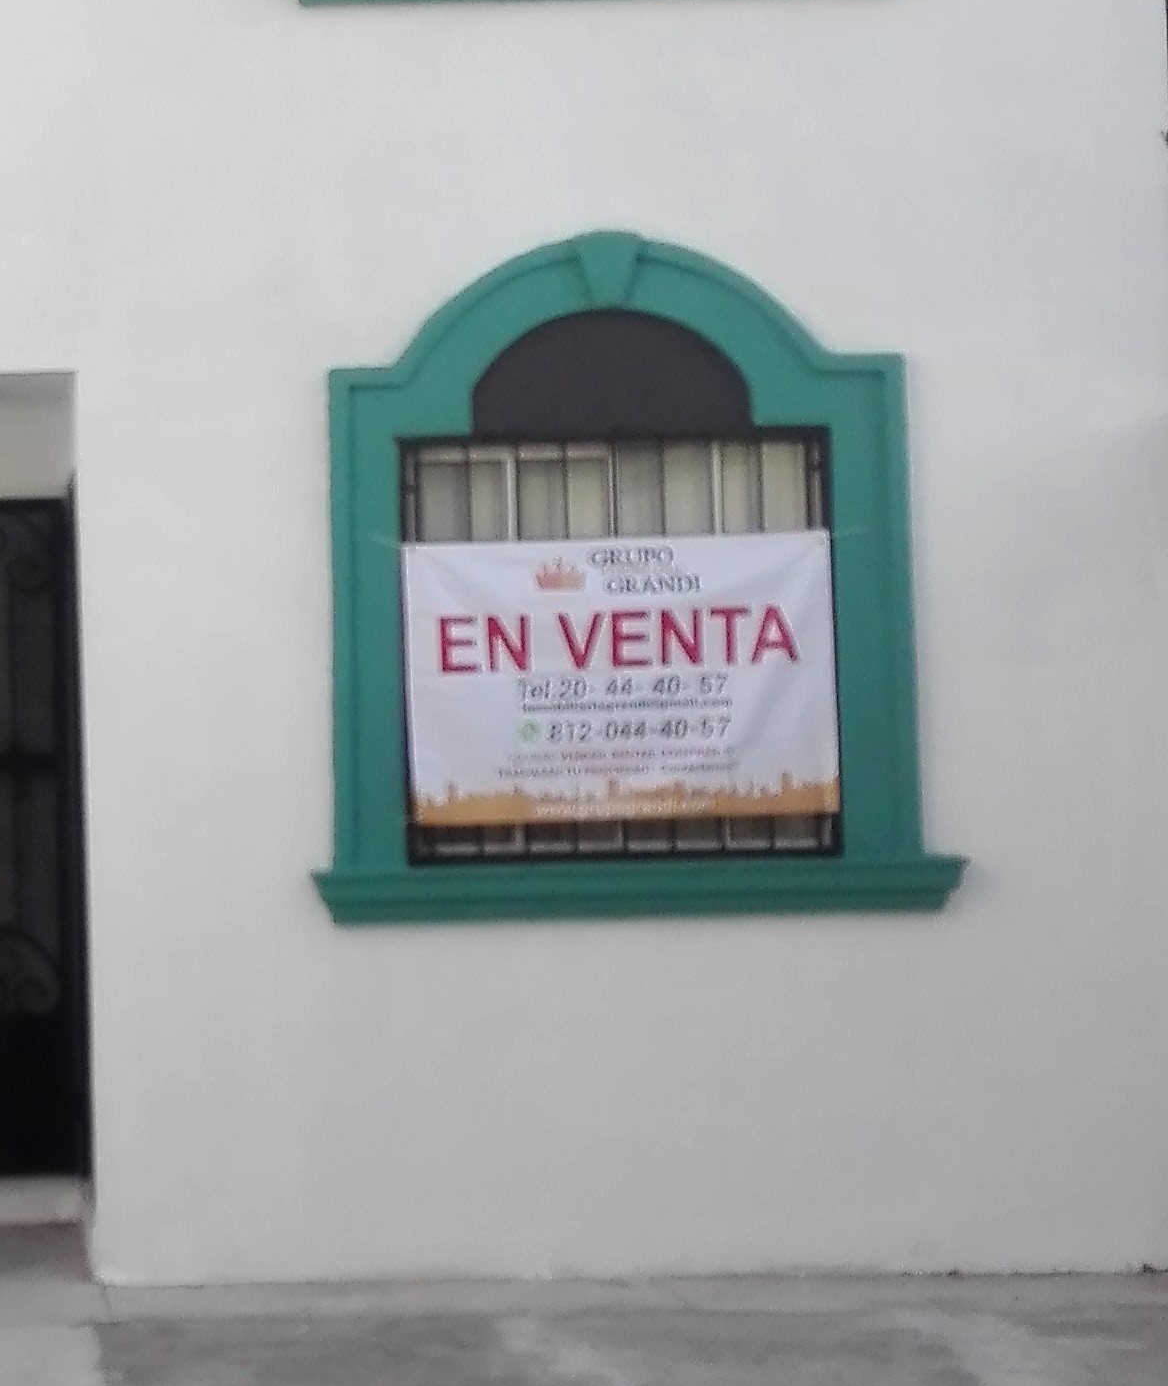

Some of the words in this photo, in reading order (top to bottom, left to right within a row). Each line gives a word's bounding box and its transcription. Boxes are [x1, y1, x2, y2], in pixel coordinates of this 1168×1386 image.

[591, 545, 675, 564] GRUPO
[606, 573, 702, 594] GRANDI
[438, 615, 531, 674] EN
[557, 603, 801, 670] VENTA
